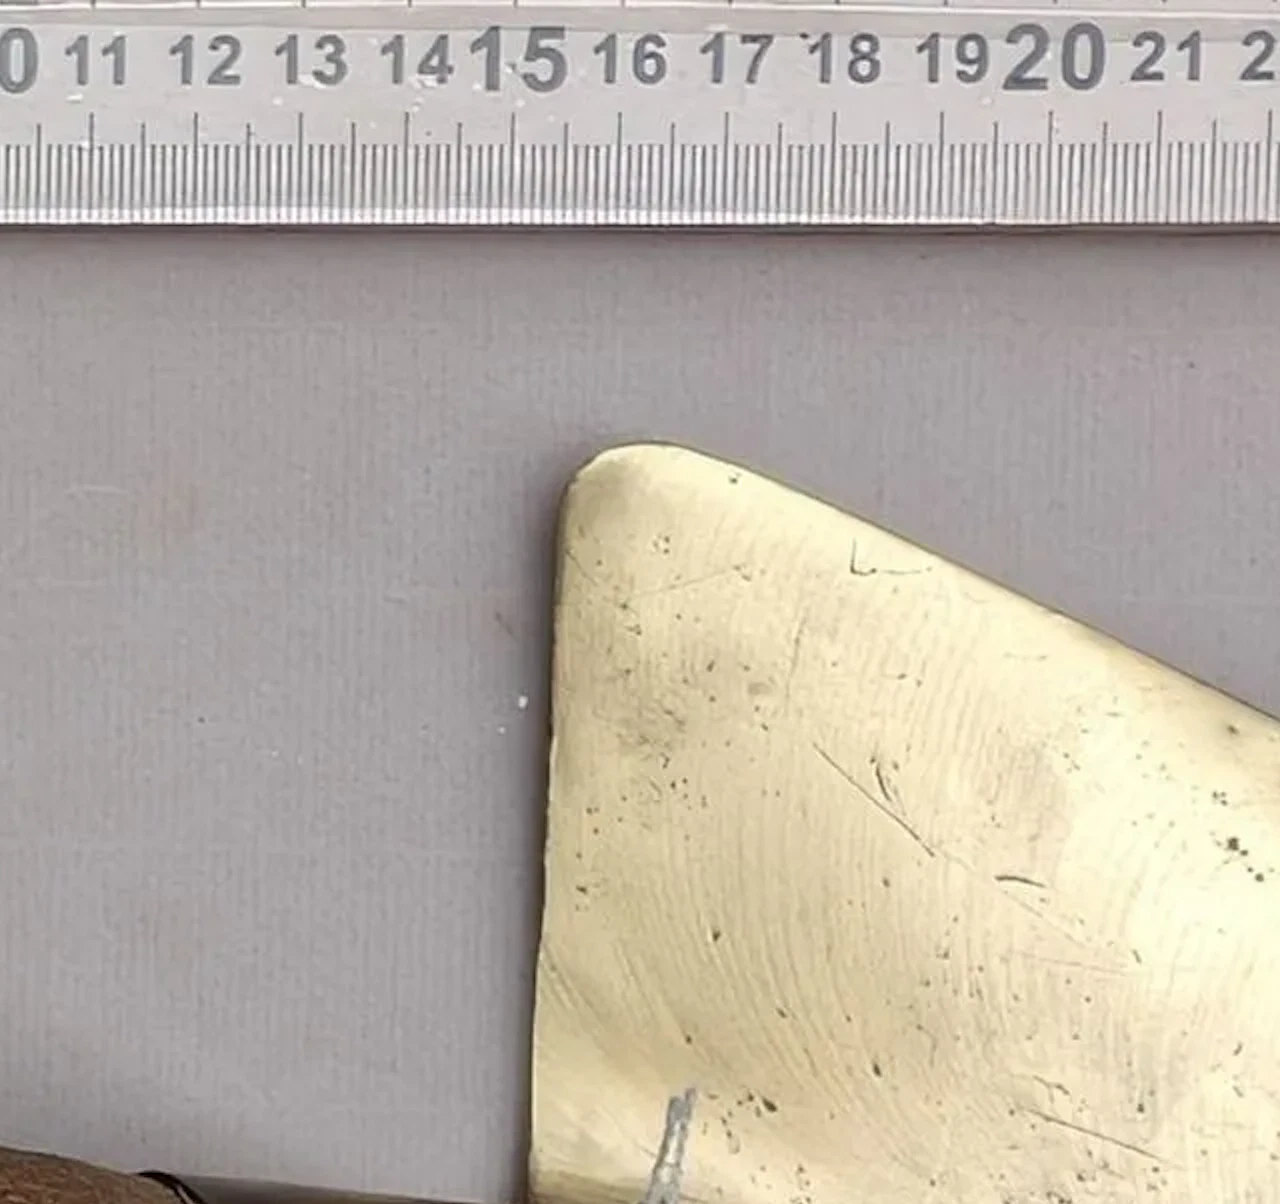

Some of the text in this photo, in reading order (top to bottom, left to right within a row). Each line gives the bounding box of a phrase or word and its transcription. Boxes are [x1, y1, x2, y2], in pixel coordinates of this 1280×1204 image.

[64, 34, 126, 87] 11
[168, 34, 242, 86] 12
[274, 33, 347, 86] 13
[380, 33, 455, 85] 14
[469, 24, 567, 93] 15
[593, 32, 667, 85] 16
[699, 31, 775, 85] 17
[808, 31, 881, 85] 18
[915, 31, 989, 84] 19
[1001, 21, 1106, 91] 20
[1129, 29, 1202, 82] 21
